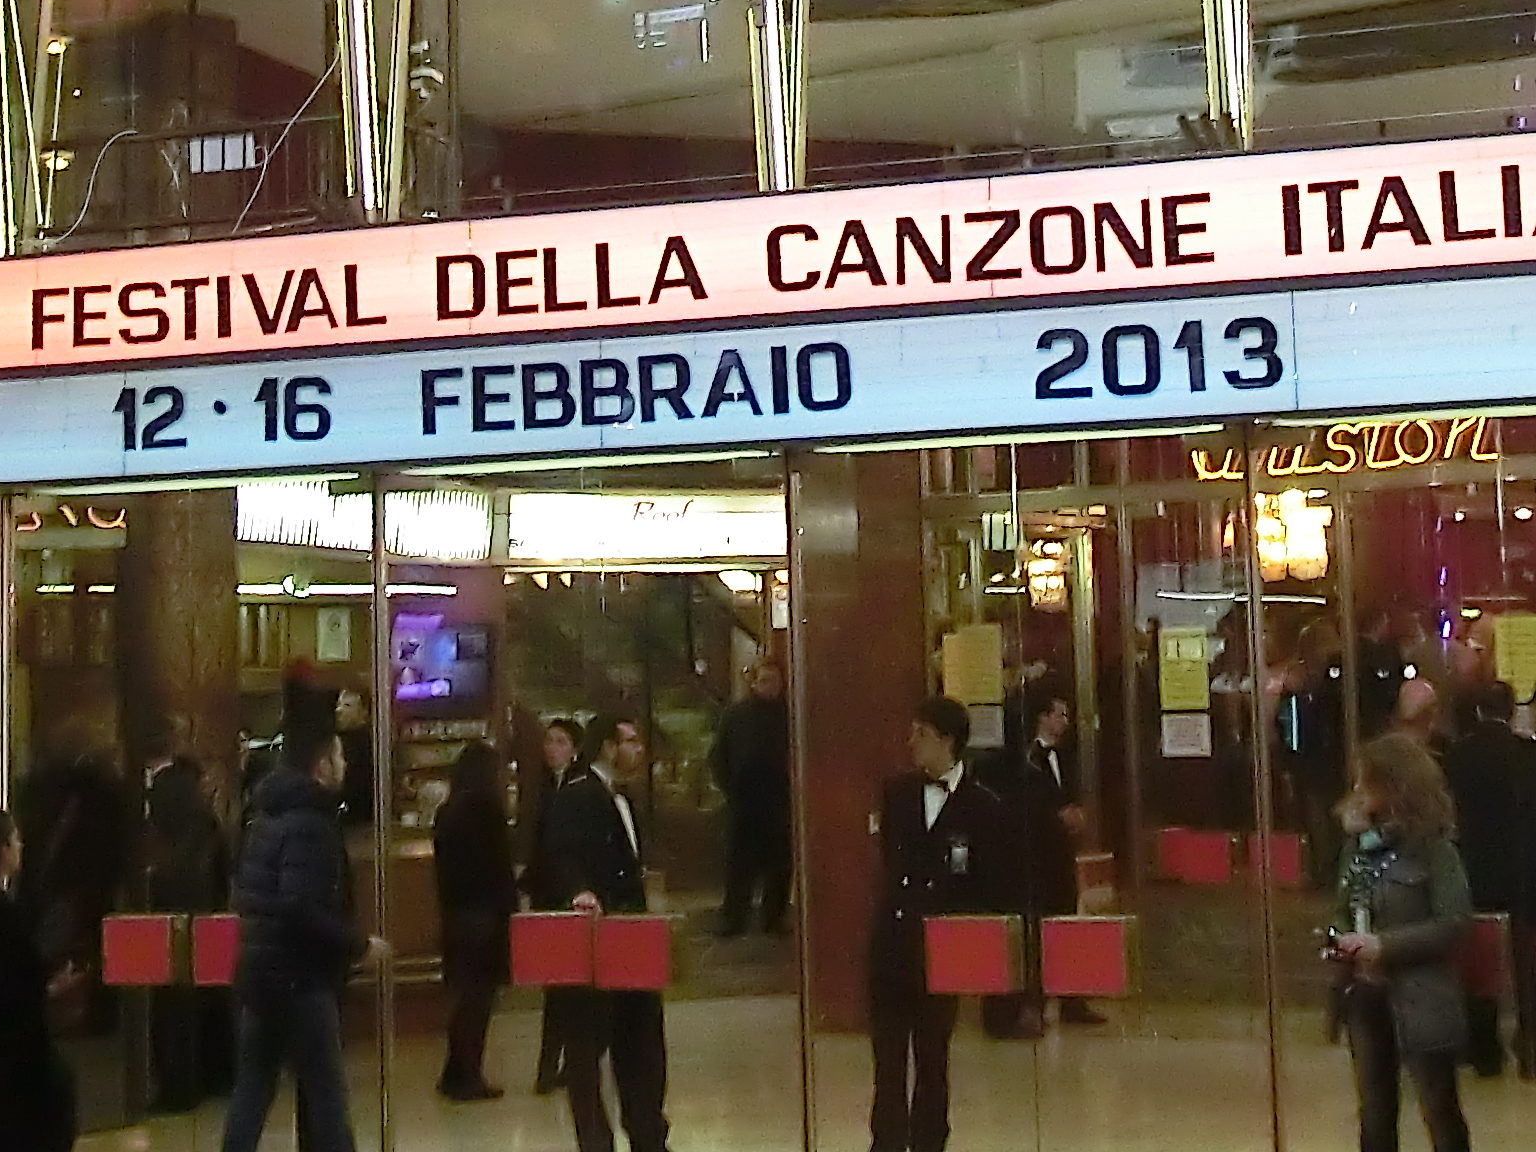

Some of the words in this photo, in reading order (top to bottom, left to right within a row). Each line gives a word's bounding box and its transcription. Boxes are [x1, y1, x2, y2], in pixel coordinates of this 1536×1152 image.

[30, 263, 386, 352] FESTIVAL
[436, 235, 708, 323] DELLA
[766, 192, 1216, 293] CANZONE
[419, 340, 853, 437] FEBBRAIO
[1033, 316, 1285, 401] 2013
